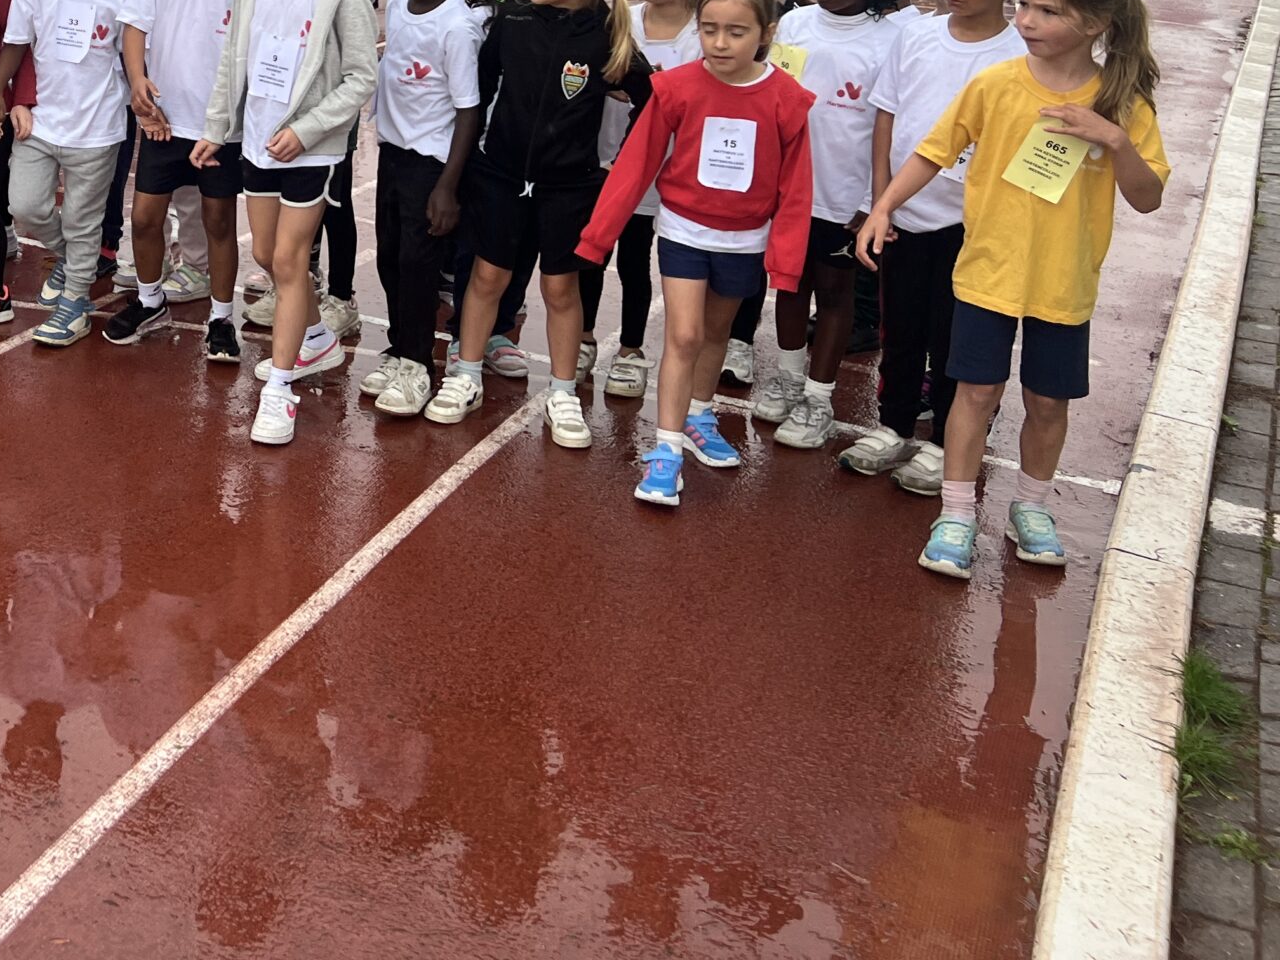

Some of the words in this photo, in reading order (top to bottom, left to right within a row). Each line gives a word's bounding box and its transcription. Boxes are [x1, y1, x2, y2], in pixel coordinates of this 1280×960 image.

[68, 18, 79, 26] 33
[272, 54, 278, 62] 9
[723, 139, 737, 149] 15
[1045, 140, 1068, 155] 665
